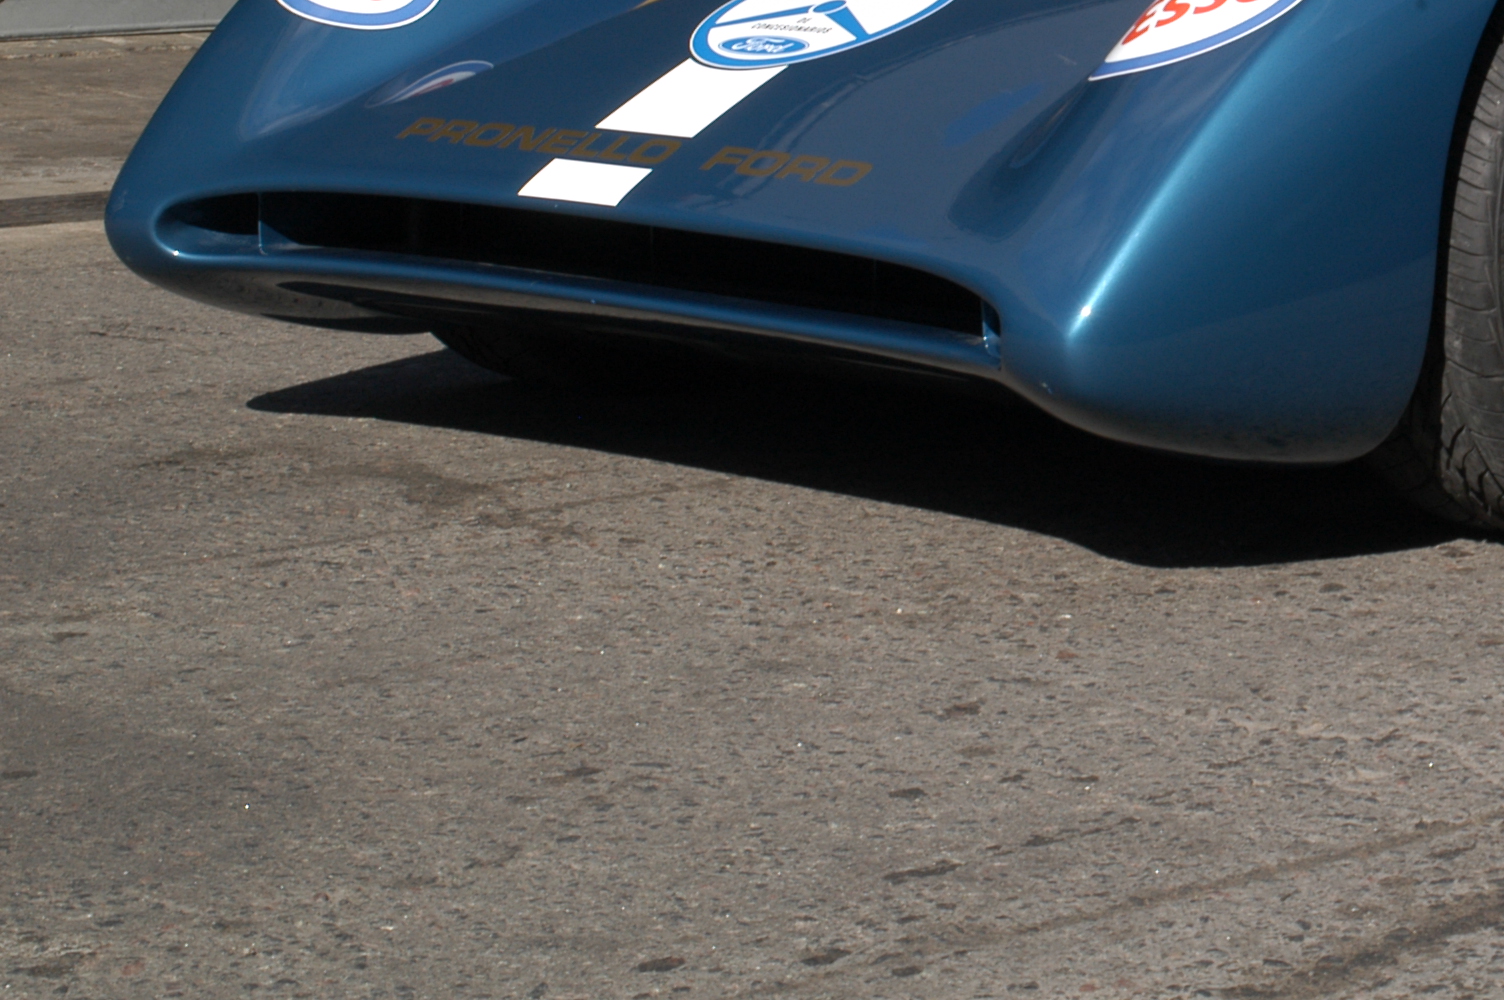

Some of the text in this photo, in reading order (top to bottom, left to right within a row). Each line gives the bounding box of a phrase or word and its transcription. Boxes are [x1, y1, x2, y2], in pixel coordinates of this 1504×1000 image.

[751, 23, 833, 34] CONCESIONARIOS
[731, 37, 796, 53] Ford
[398, 116, 873, 187] PRONELLO FORD
